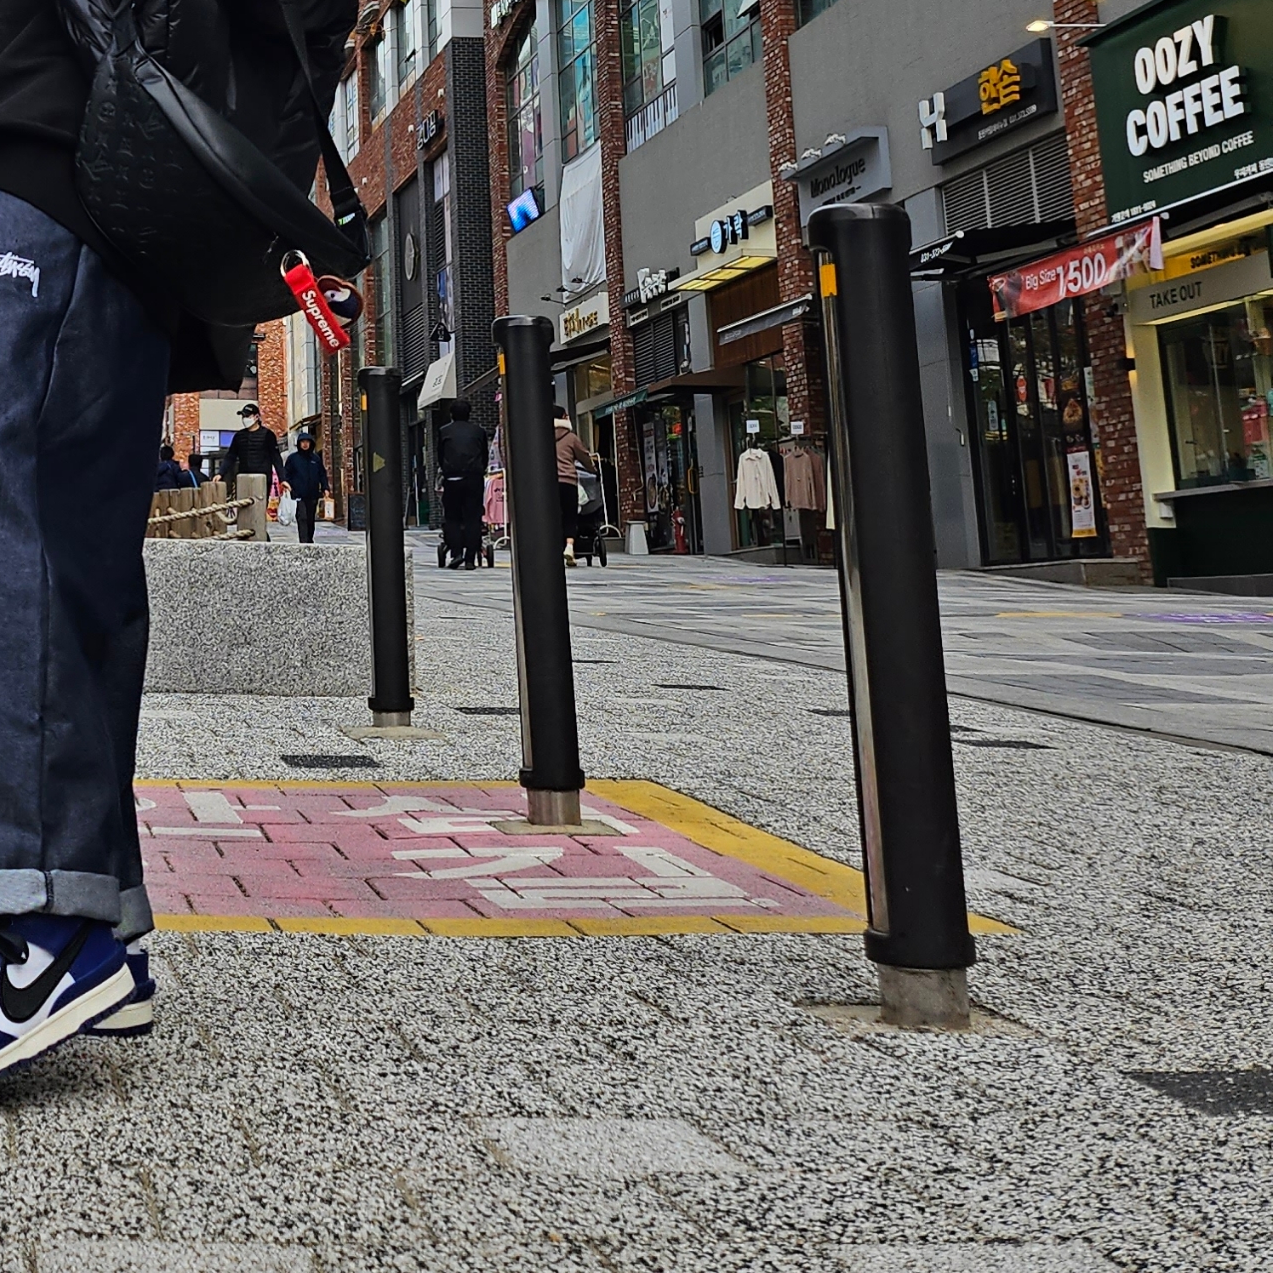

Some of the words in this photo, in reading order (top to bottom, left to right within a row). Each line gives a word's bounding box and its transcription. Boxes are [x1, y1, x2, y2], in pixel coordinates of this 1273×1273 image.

[1134, 15, 1215, 95] OOZY
[1127, 65, 1244, 157] COFFEE
[810, 156, 866, 199] Monologue
[1143, 157, 1187, 183] SOMETHING
[1188, 144, 1220, 166] BEYOND
[1222, 131, 1254, 154] COFFEE
[1025, 273, 1038, 291] Big
[1038, 267, 1056, 286] Size
[1149, 286, 1177, 310] TAKE
[1179, 281, 1202, 304] OUT
[300, 289, 341, 351] Supreme
